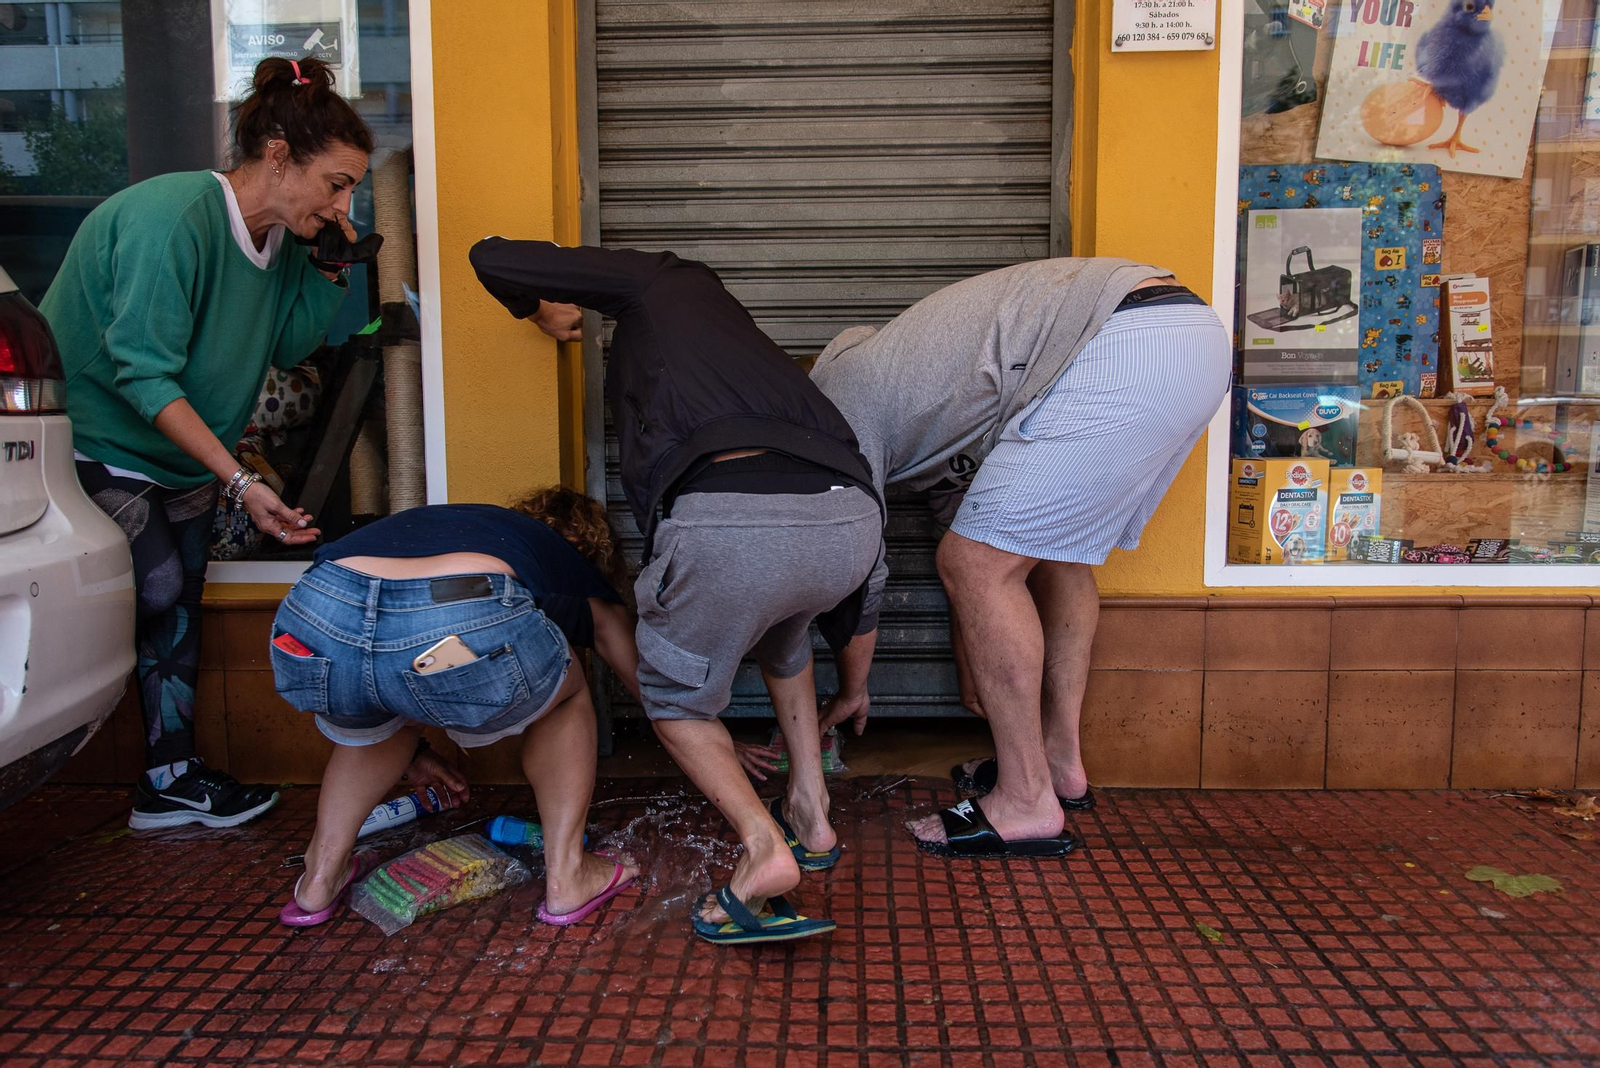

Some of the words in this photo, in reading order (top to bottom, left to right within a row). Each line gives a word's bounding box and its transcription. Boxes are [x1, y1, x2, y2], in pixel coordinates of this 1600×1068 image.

[1350, 0, 1414, 27] YOUR
[248, 34, 285, 46] AVISO
[1357, 40, 1406, 70] LIFE
[1256, 217, 1277, 228] ebi
[2, 440, 35, 462] TDI
